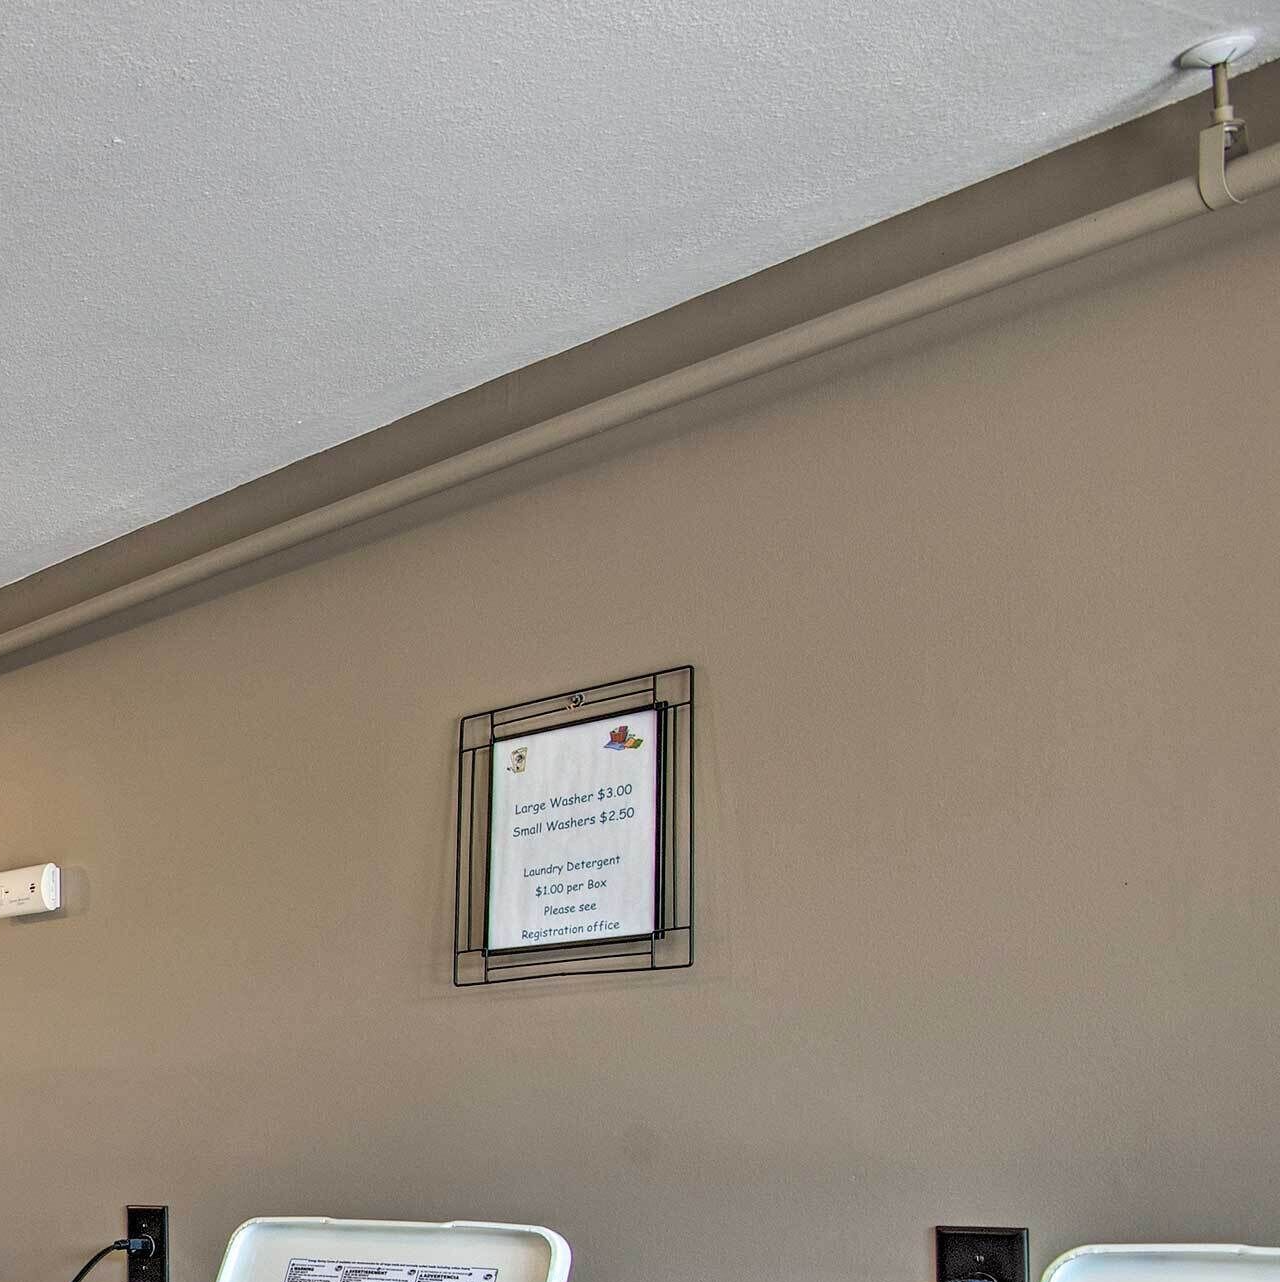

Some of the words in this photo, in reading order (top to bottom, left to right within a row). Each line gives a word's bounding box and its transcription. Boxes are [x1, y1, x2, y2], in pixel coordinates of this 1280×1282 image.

[514, 801, 546, 815] Large
[550, 792, 593, 808] Washer
[597, 783, 633, 801] $3.00
[512, 823, 542, 838] Small
[546, 815, 596, 831] Washers
[599, 807, 635, 824] $2.50
[523, 863, 563, 878] Laundry
[566, 855, 621, 872] Detergent
[535, 883, 564, 898] $1.00
[566, 882, 584, 895] per
[587, 879, 607, 889] Box
[543, 905, 576, 916] Please
[579, 902, 597, 912] see
[521, 924, 584, 941] Registration
[586, 920, 620, 933] office
